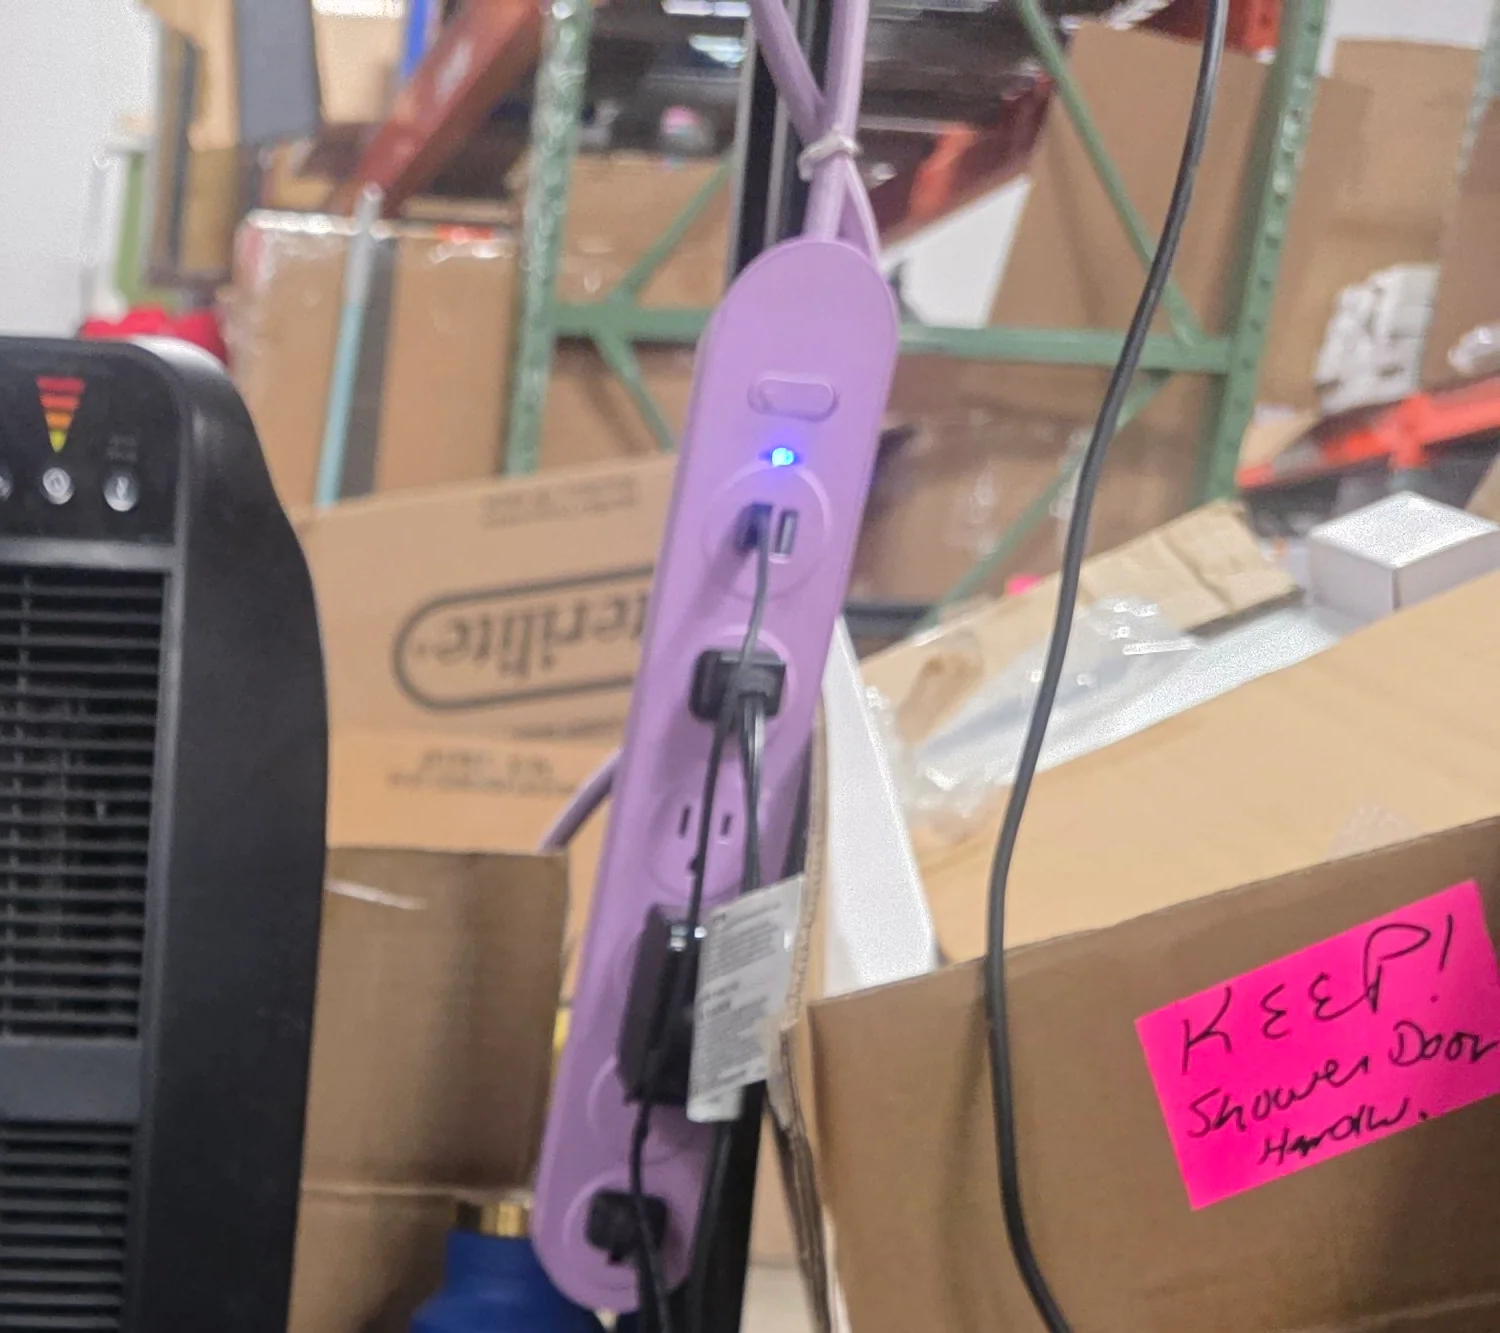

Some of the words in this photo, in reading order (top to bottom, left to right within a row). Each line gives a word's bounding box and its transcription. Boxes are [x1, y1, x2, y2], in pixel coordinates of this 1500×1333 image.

[1179, 913, 1455, 1075] KEEP!
[1185, 1054, 1371, 1139] Shower
[1388, 1020, 1500, 1068] Door
